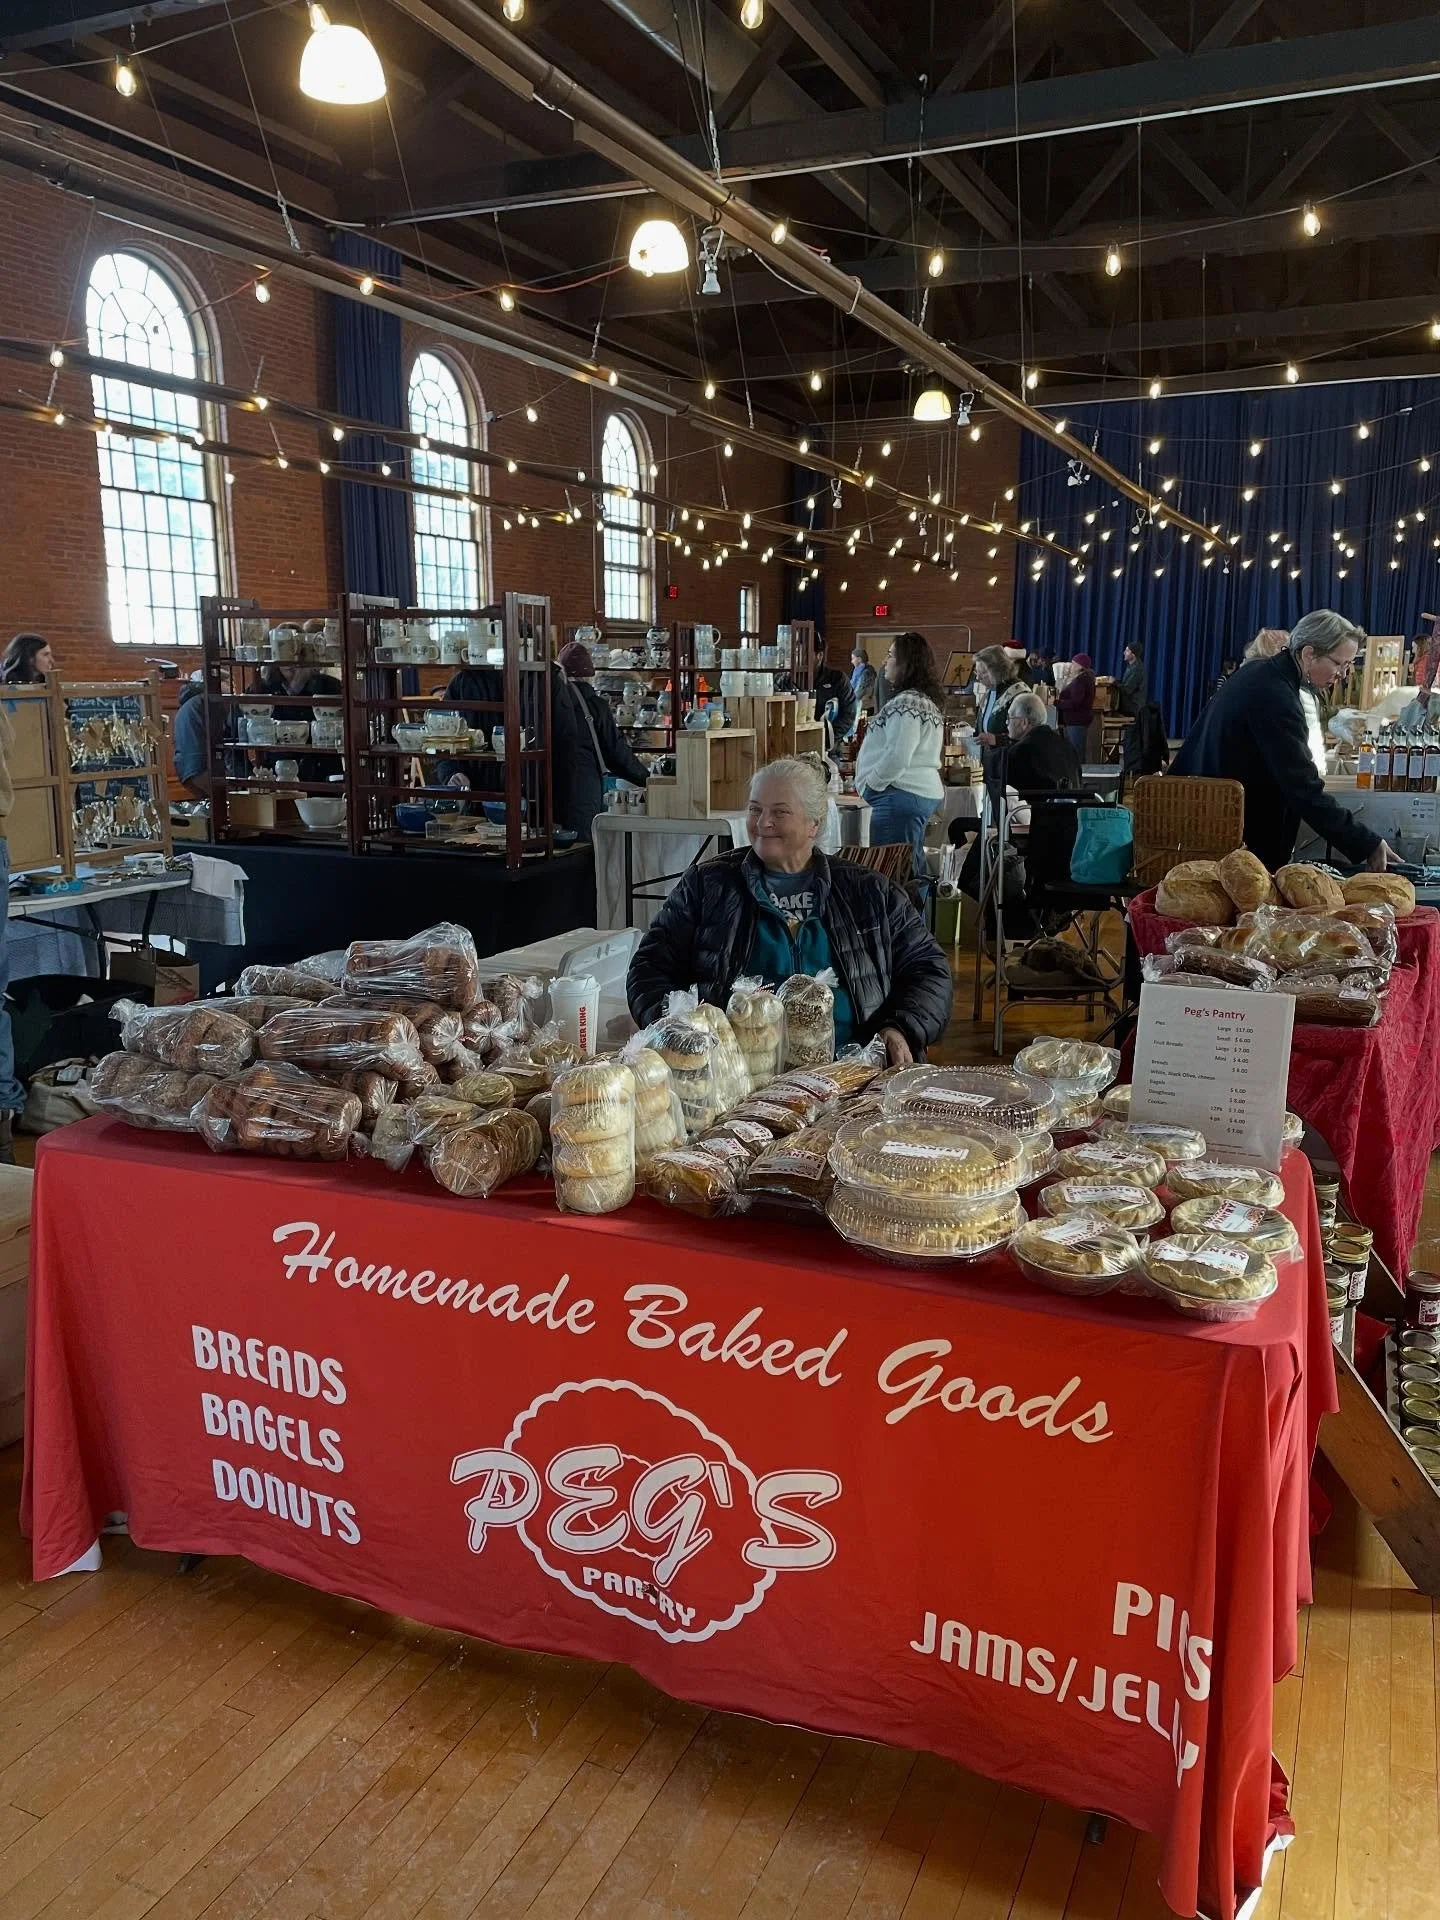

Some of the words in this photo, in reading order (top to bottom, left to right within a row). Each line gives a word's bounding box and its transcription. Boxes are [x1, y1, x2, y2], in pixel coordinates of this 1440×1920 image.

[1184, 1006, 1210, 1018] Peg's
[1212, 1009, 1246, 1021] Pantry
[192, 1324, 347, 1405] BREADS
[272, 1221, 596, 1335] Homemade
[623, 1283, 848, 1387] Baked
[877, 1339, 1113, 1444] Goods
[201, 1392, 345, 1474] BAGELS
[212, 1458, 361, 1546] DONUTS
[450, 1444, 842, 1588] PEG'S
